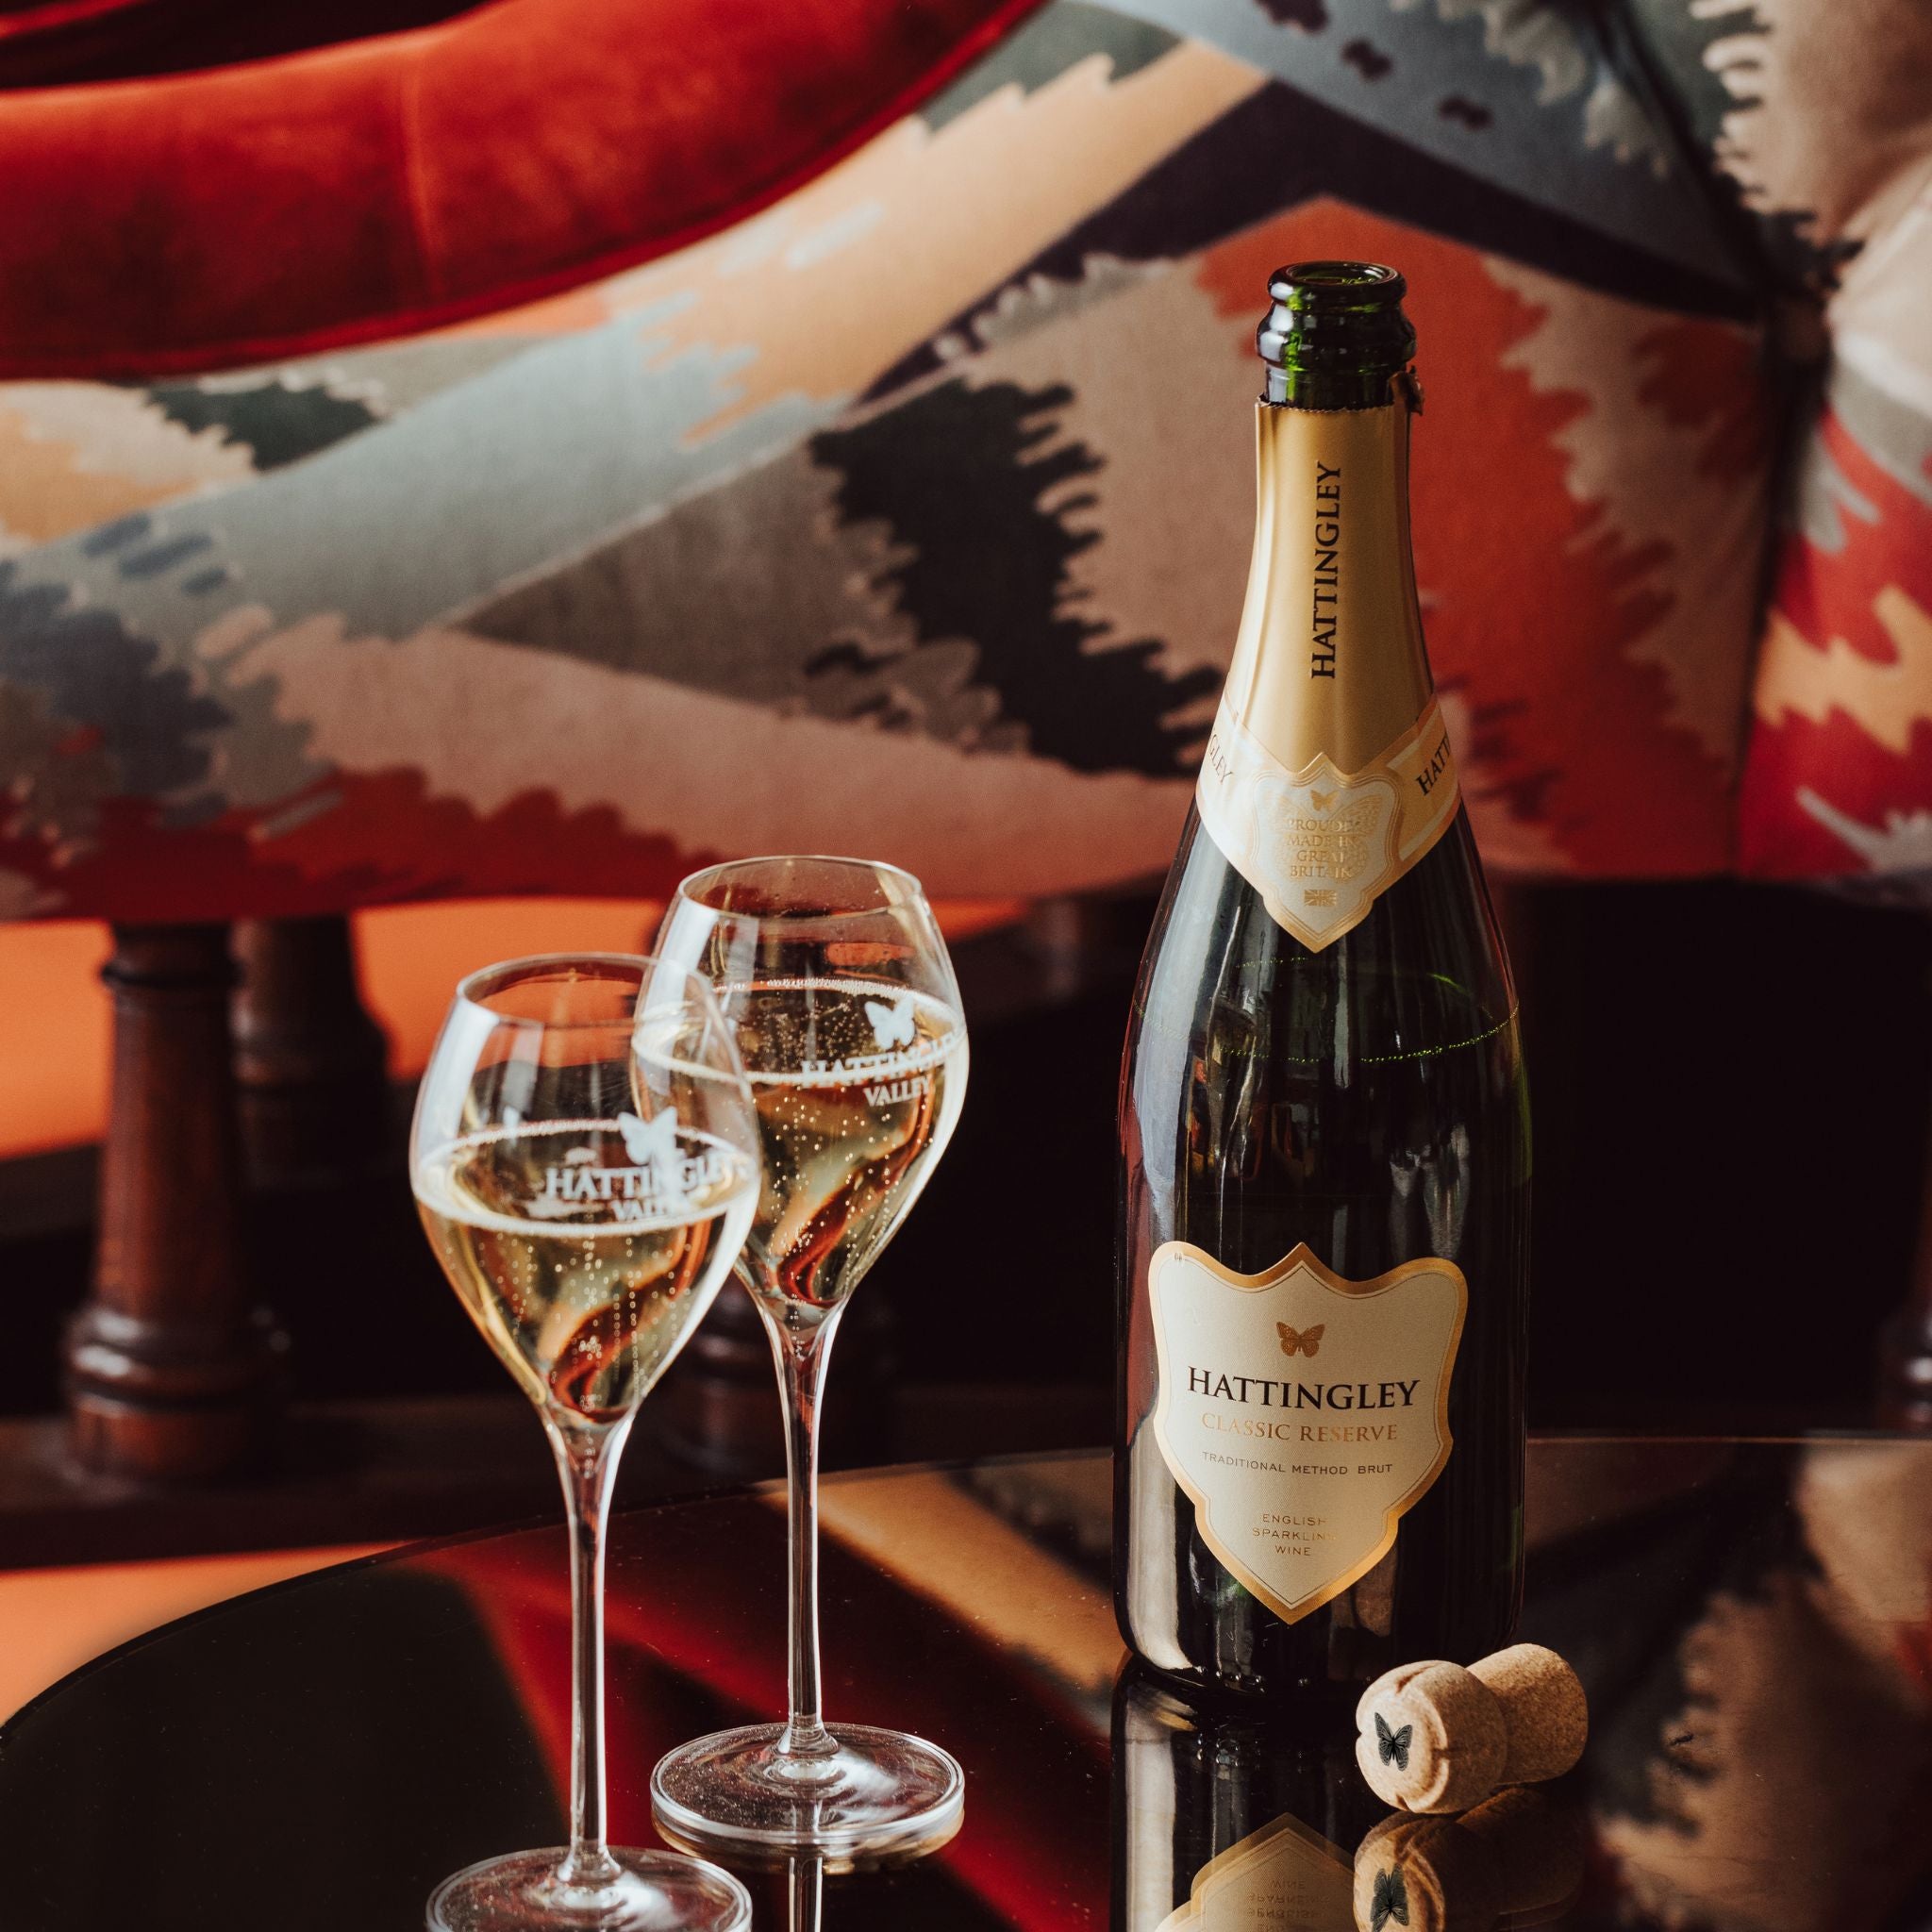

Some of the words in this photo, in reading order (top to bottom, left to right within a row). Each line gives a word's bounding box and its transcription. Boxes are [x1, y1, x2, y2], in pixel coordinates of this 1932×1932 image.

[1311, 460, 1341, 679] HATTINGLEY
[1287, 835, 1331, 847] MADE
[1297, 850, 1344, 863] GREAT
[1188, 1366, 1421, 1410] HATTINGLEY
[1201, 1412, 1291, 1441] CLASSIC
[1299, 1424, 1398, 1442] RESERVE
[1202, 1451, 1286, 1474] TRADITIONAL
[1291, 1464, 1348, 1475] METHOD
[1357, 1463, 1393, 1474] BRUT
[1262, 1513, 1327, 1526] ENGLISH
[1252, 1527, 1336, 1541] SPARKLIN
[1274, 1545, 1312, 1557] WINE
